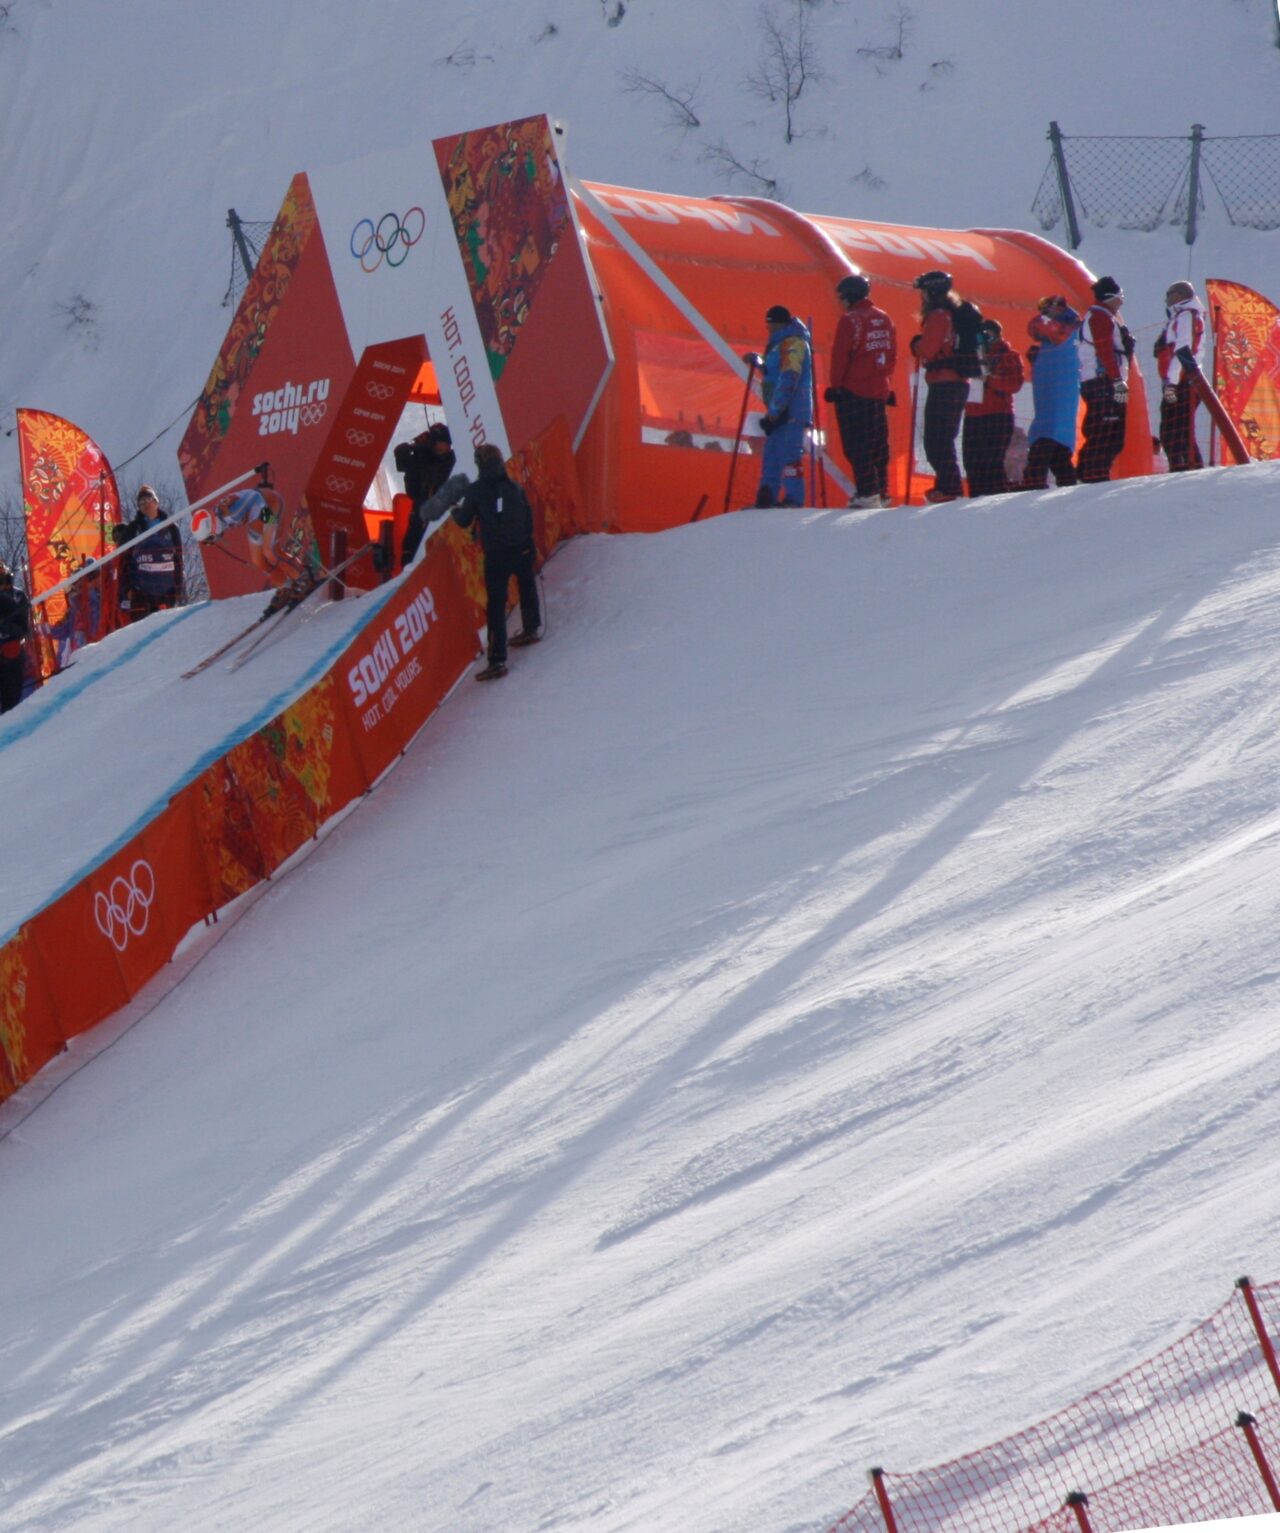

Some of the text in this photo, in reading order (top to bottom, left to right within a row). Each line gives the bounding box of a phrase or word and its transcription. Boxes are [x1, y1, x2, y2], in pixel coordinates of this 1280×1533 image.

[820, 222, 998, 272] 2014
[440, 305, 463, 359] HOT.
[452, 355, 476, 419] COOL.
[251, 378, 330, 416] sochi.ru
[258, 407, 300, 436] 2014
[348, 586, 438, 708] SOCHI 2014
